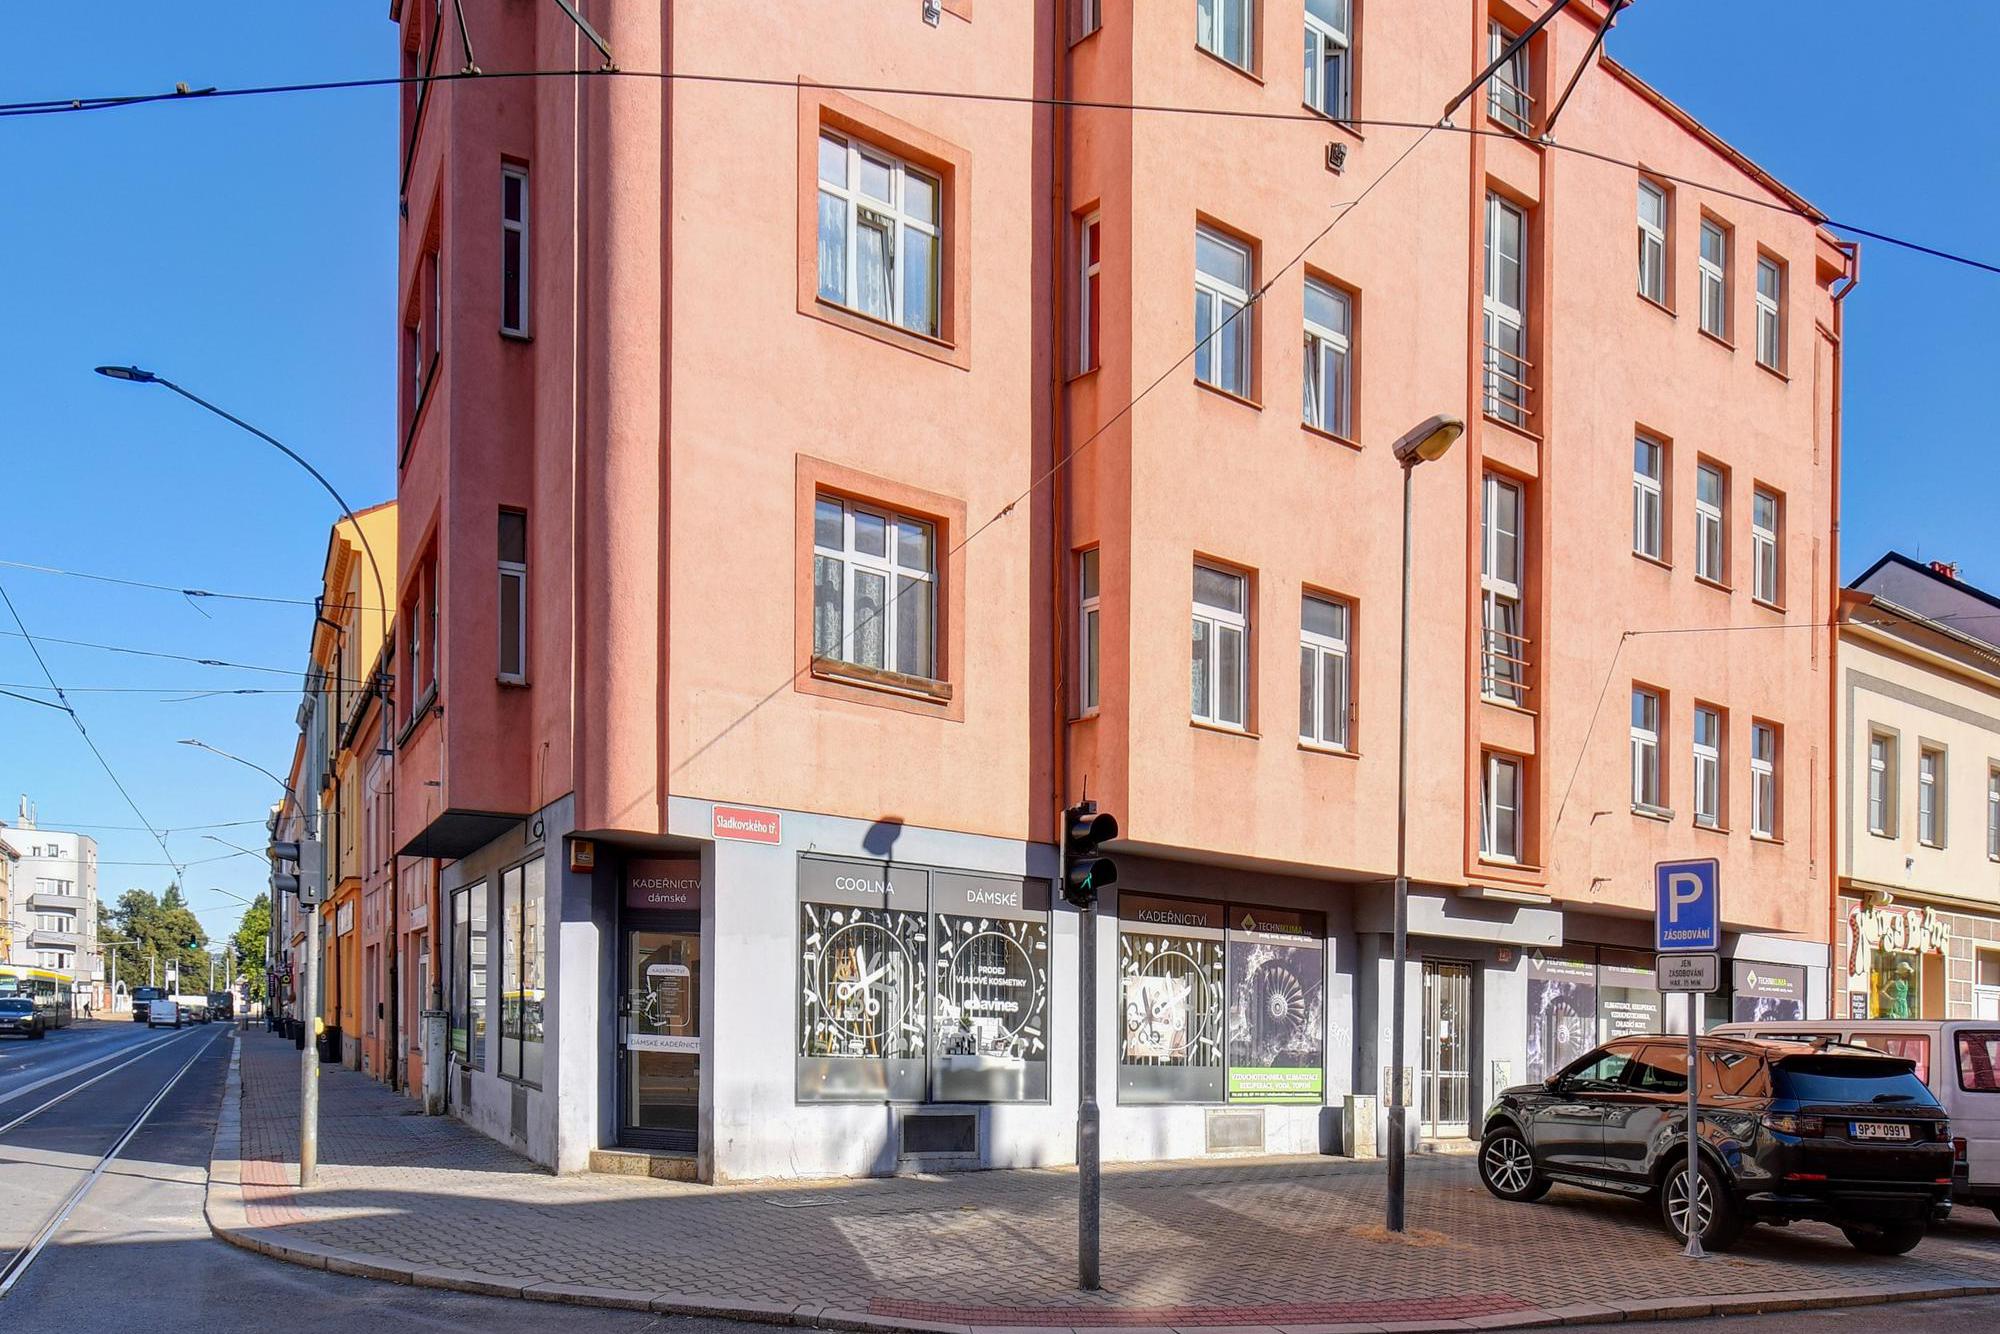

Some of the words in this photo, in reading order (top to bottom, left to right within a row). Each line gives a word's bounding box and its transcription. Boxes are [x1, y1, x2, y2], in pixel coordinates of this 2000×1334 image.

[716, 815, 768, 833] Sladkovského
[768, 821, 778, 835] tř.
[835, 876, 895, 895] COOLNA
[647, 892, 687, 903] dámské
[967, 887, 1018, 906] DÁMSKÉ
[1668, 872, 1703, 923] P
[1138, 909, 1207, 926] KADEŘNICTVÍ
[1663, 927, 1710, 941] ZÁSOBOVÁNÍ
[978, 965, 1006, 975] PRODEJ
[1680, 959, 1692, 968] JEN
[1668, 968, 1704, 978] ZÁSOBOVÁNÍ
[956, 975, 988, 985] VLASOVÉ
[988, 977, 1027, 987] KOSMETIKY
[964, 991, 1019, 1012] davines
[630, 1037, 658, 1047] DÁMSKÉ
[1857, 1124, 1876, 1135] 9P3
[1883, 1124, 1906, 1136] 0991
